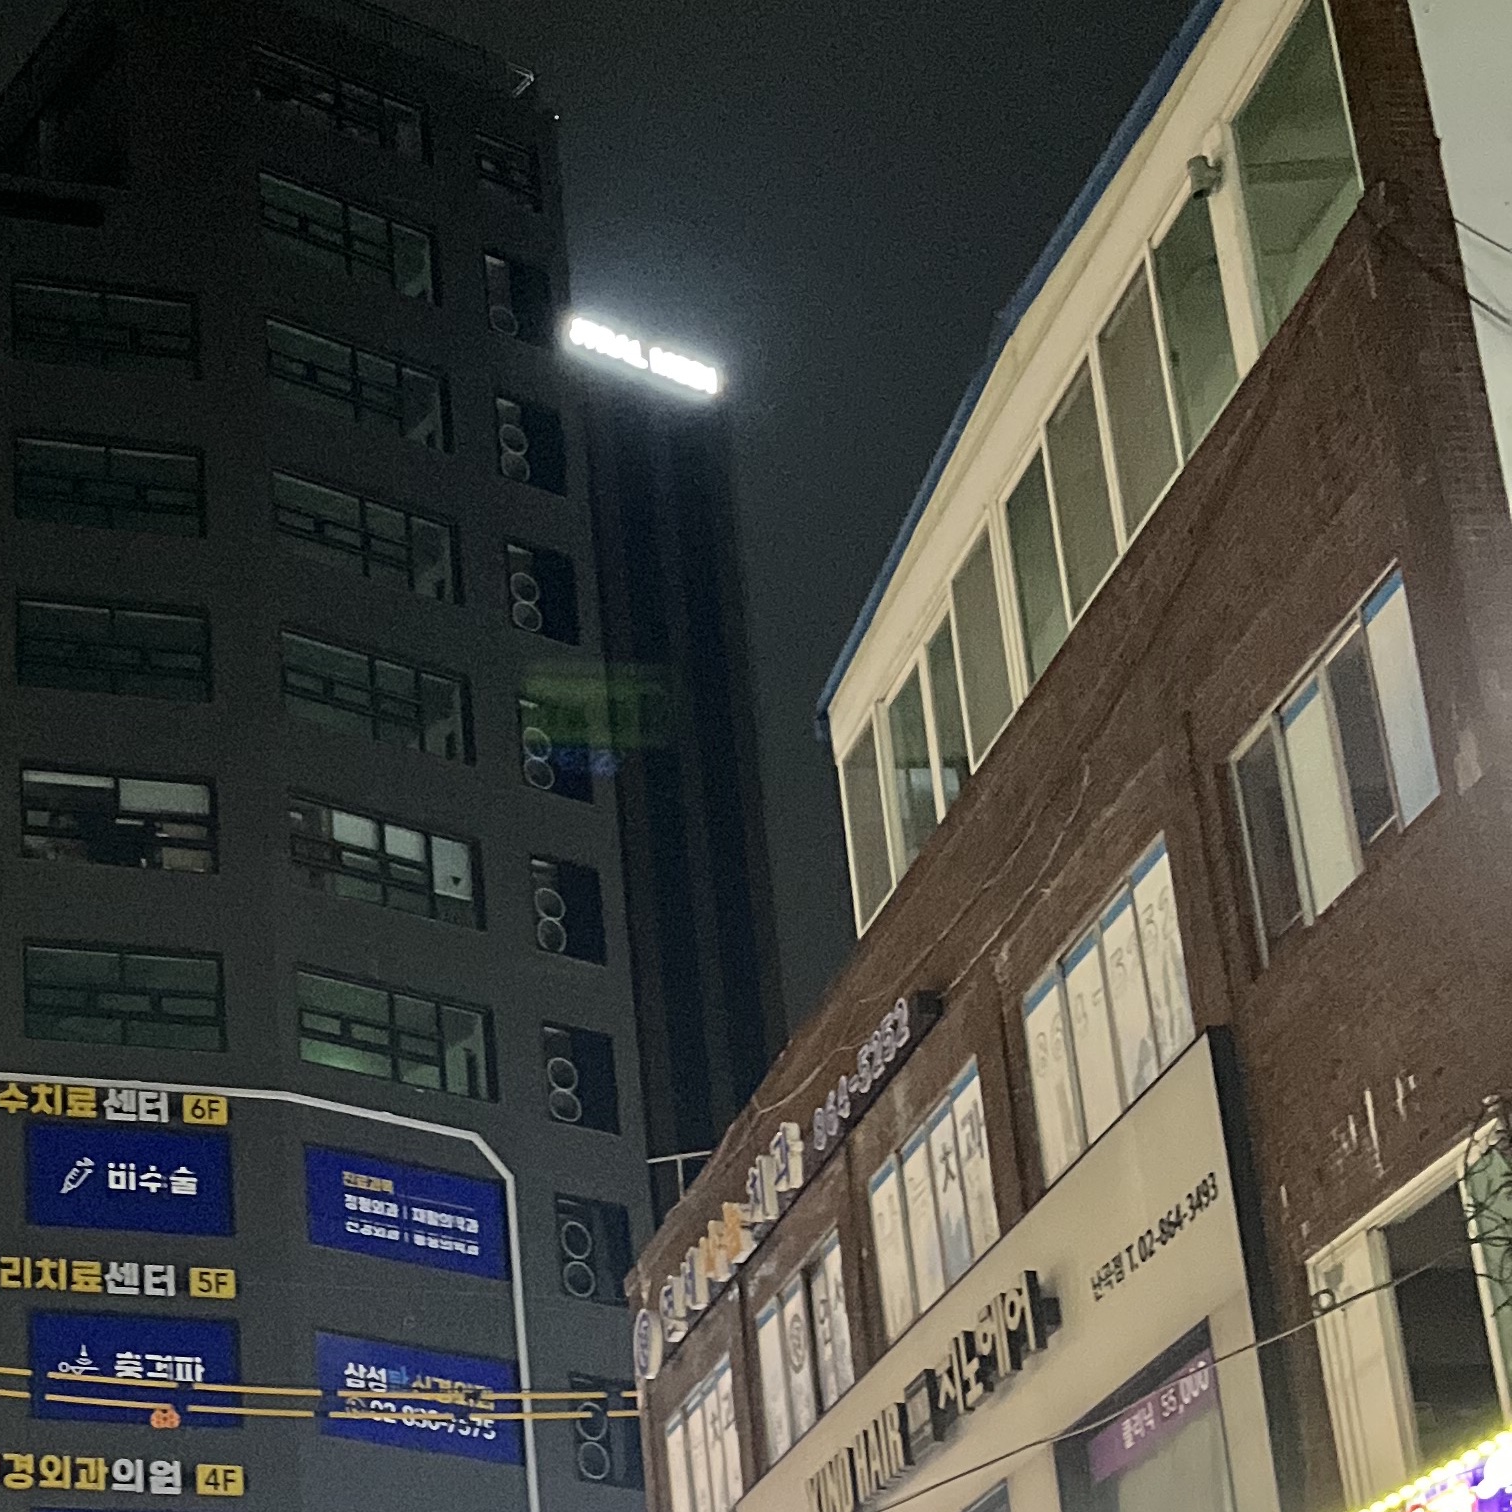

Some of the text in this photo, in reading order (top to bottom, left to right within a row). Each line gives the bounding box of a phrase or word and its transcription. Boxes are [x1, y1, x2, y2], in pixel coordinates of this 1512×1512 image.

[187, 1096, 225, 1123] 6F
[107, 1161, 198, 1197] 비수술
[193, 1271, 234, 1296] 5F
[853, 1403, 906, 1505] HAIR
[200, 1466, 241, 1493] 4F
